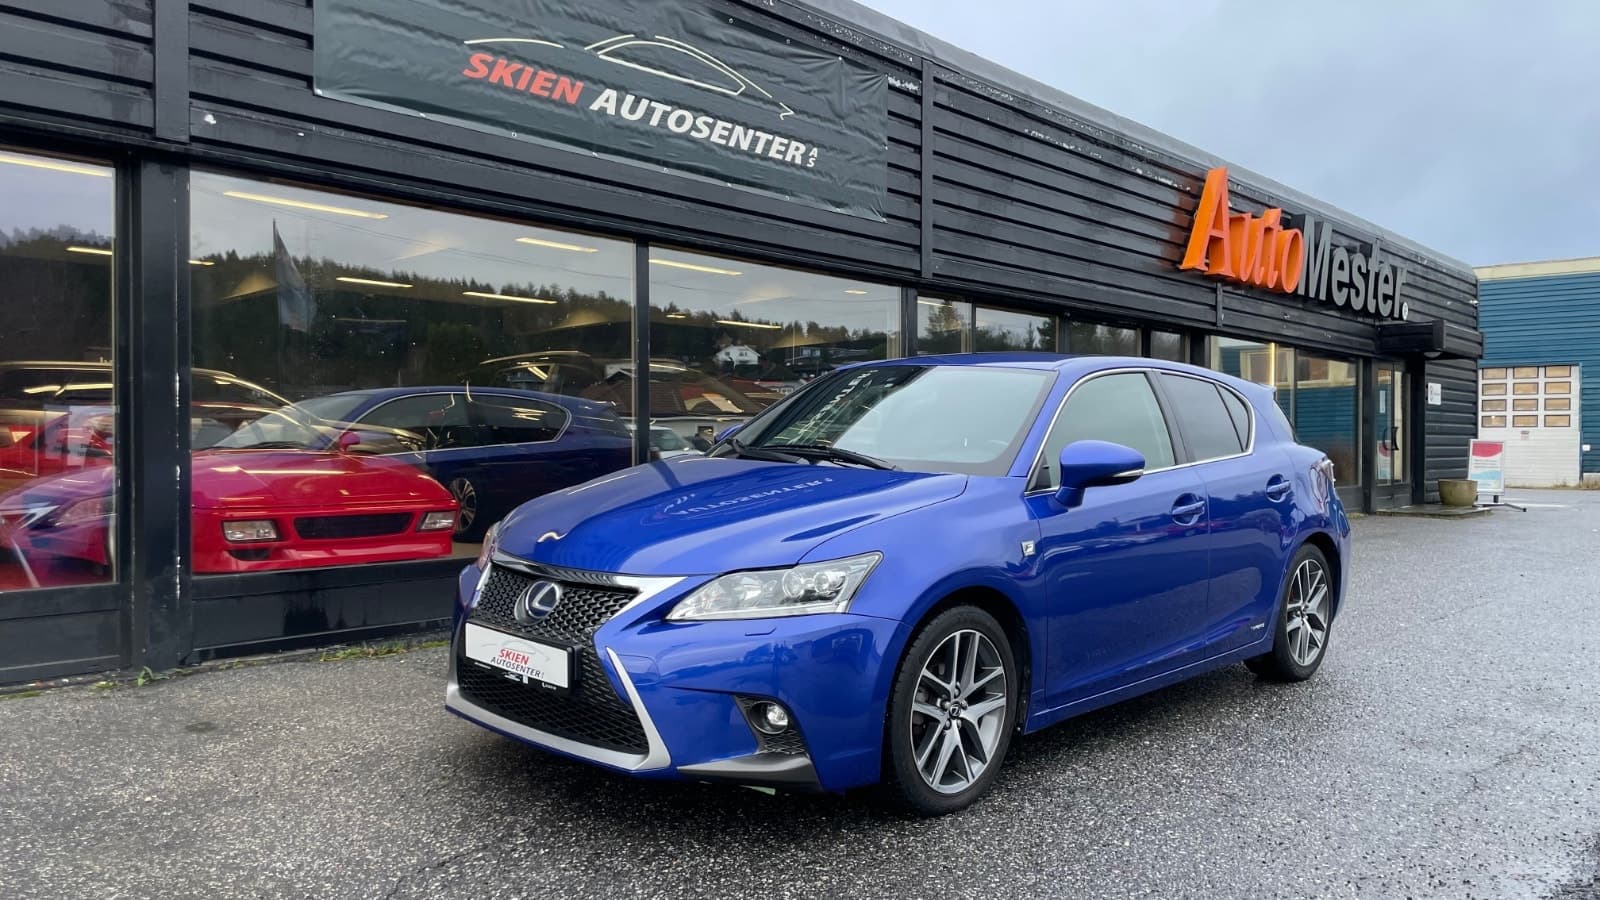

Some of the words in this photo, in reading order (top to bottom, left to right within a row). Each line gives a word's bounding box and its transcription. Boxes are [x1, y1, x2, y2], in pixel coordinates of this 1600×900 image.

[463, 52, 585, 105] SKIEN
[589, 87, 806, 166] AUTOSENTER
[490, 656, 541, 678] AUTOSENTER
[499, 648, 530, 666] SKIEN
